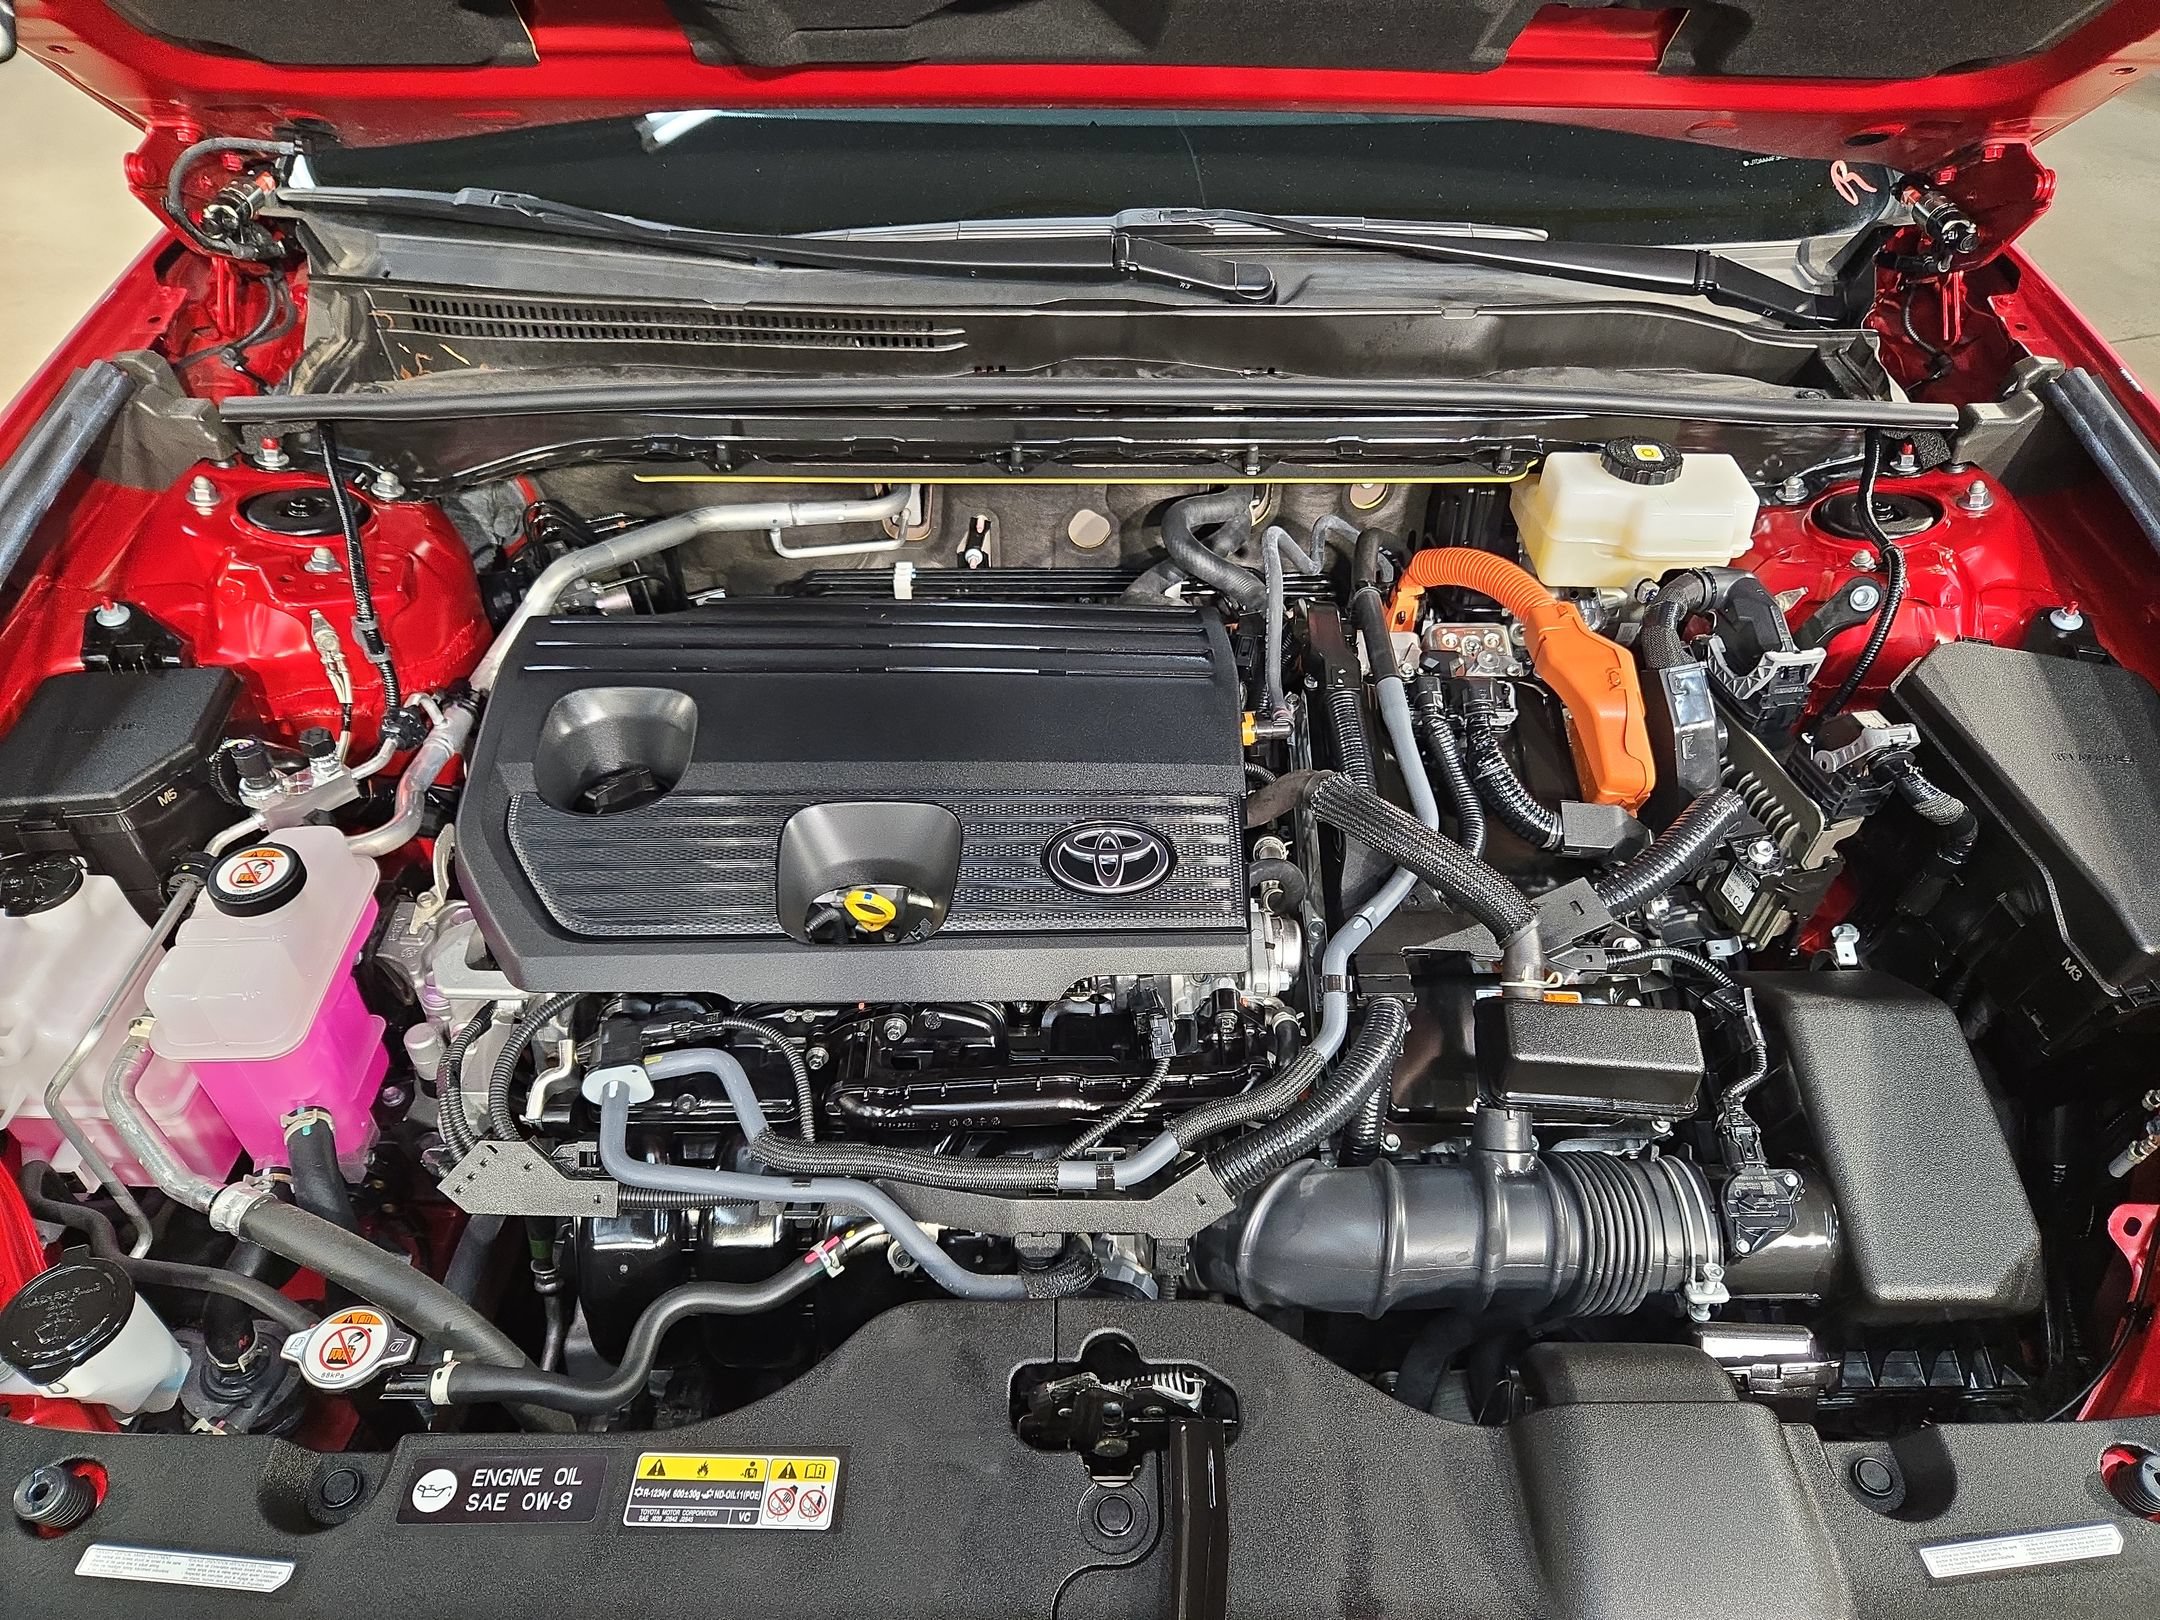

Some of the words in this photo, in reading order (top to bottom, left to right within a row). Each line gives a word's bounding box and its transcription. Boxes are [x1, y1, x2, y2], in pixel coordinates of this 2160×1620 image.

[1830, 160, 1878, 207] R
[157, 788, 178, 807] M5
[1733, 896, 1744, 911] C2
[2061, 957, 2083, 982] M3
[472, 1467, 545, 1487] ENGINE
[553, 1466, 583, 1486] OIL
[465, 1492, 509, 1512] SAE
[521, 1491, 573, 1511] 0W-8
[640, 1508, 660, 1516] TOYOTA
[681, 1509, 719, 1517] CORPORATION
[738, 1511, 752, 1523] VC
